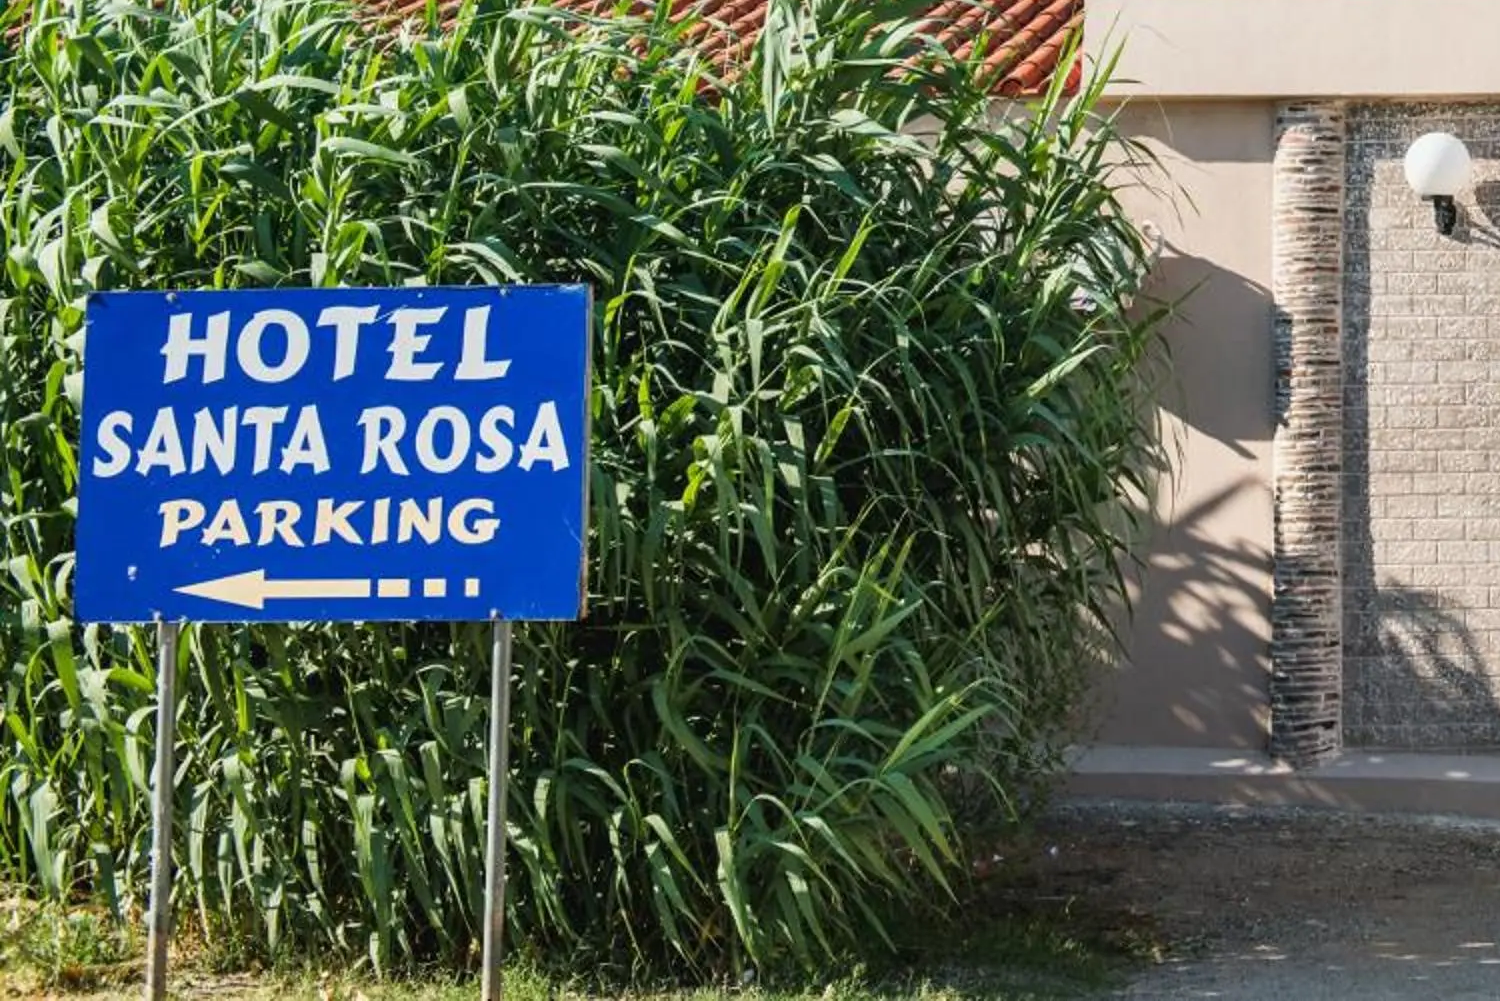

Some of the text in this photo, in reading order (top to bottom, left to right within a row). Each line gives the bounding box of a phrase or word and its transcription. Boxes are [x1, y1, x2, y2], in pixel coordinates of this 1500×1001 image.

[160, 305, 512, 384] HOTEL
[92, 401, 570, 478] SANTA ROSA
[159, 496, 500, 548] PARKING
